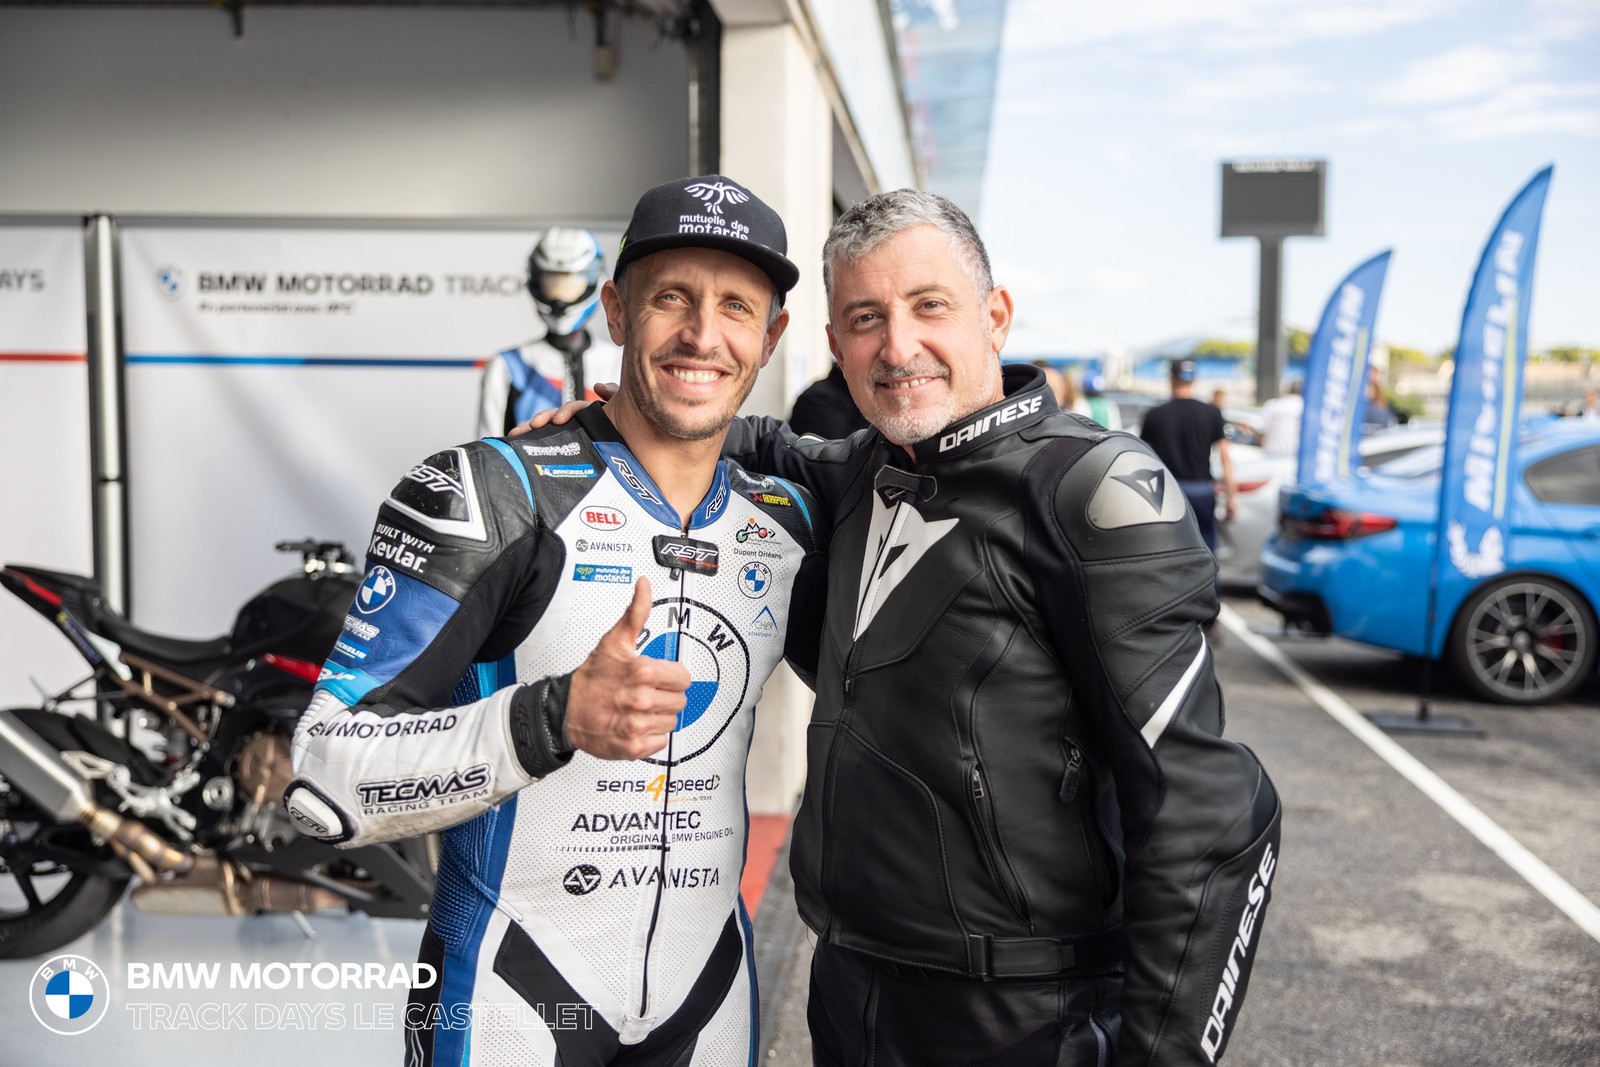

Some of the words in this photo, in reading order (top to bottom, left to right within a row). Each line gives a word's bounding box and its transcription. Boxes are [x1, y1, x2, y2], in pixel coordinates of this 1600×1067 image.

[680, 214, 726, 227] mutuelle
[731, 220, 750, 234] des
[198, 272, 267, 296] BMW
[275, 272, 434, 297] MOTORRAD
[1314, 281, 1366, 484] MICHELIN
[939, 395, 1043, 453] DAINESE
[611, 456, 663, 505] RST
[586, 511, 621, 525] BELL
[376, 523, 401, 540] BUILT
[401, 532, 435, 553] WITH
[590, 541, 634, 553] AVANISTA
[660, 542, 718, 562] RST
[733, 547, 757, 557] Dupont
[758, 550, 782, 560] Orléans
[594, 573, 631, 583] motards
[743, 563, 769, 575] BMW
[335, 714, 458, 739] MOTORRAD
[356, 763, 491, 807] TECMAS
[364, 801, 430, 816] RACING
[439, 788, 489, 806] TEAM
[289, 805, 330, 834] RST
[570, 810, 702, 833] ADVANTEC
[610, 833, 671, 845] ORIGINAL
[671, 832, 693, 844] BMW
[694, 829, 724, 842] ENGINE
[724, 826, 734, 837] OIL
[608, 865, 720, 889] AVANISTA
[1201, 842, 1276, 1063] DAINESE
